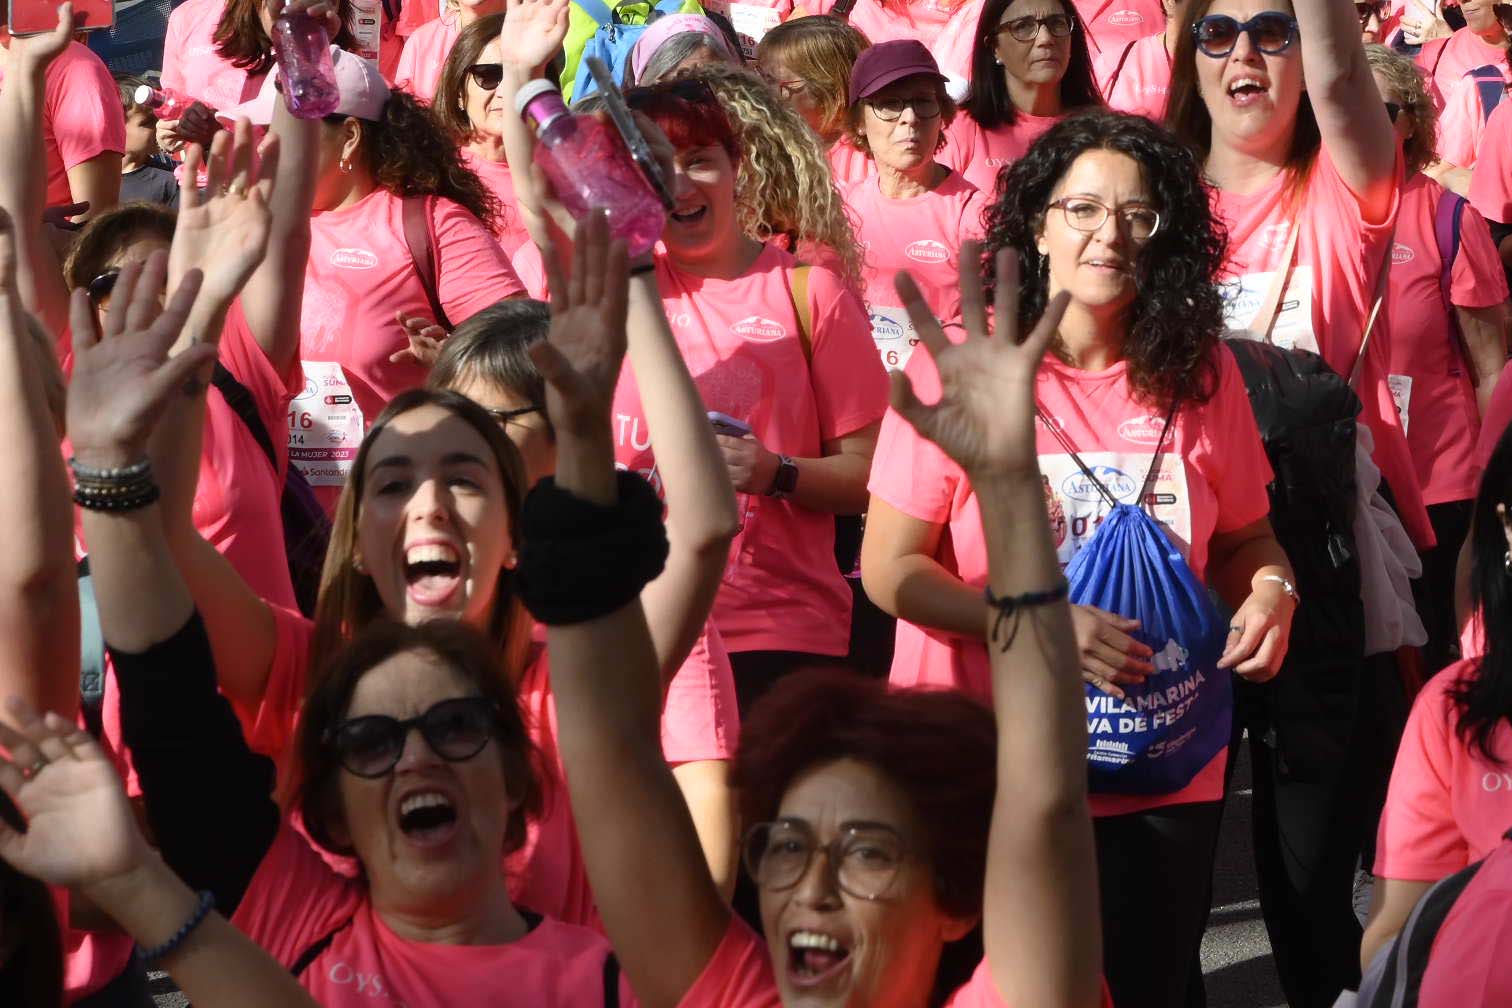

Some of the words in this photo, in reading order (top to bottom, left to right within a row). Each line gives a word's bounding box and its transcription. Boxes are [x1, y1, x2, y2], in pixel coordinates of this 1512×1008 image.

[1085, 669, 1206, 714] VILAMARINA
[1119, 716, 1148, 733] DE
[328, 961, 389, 998] OYS
